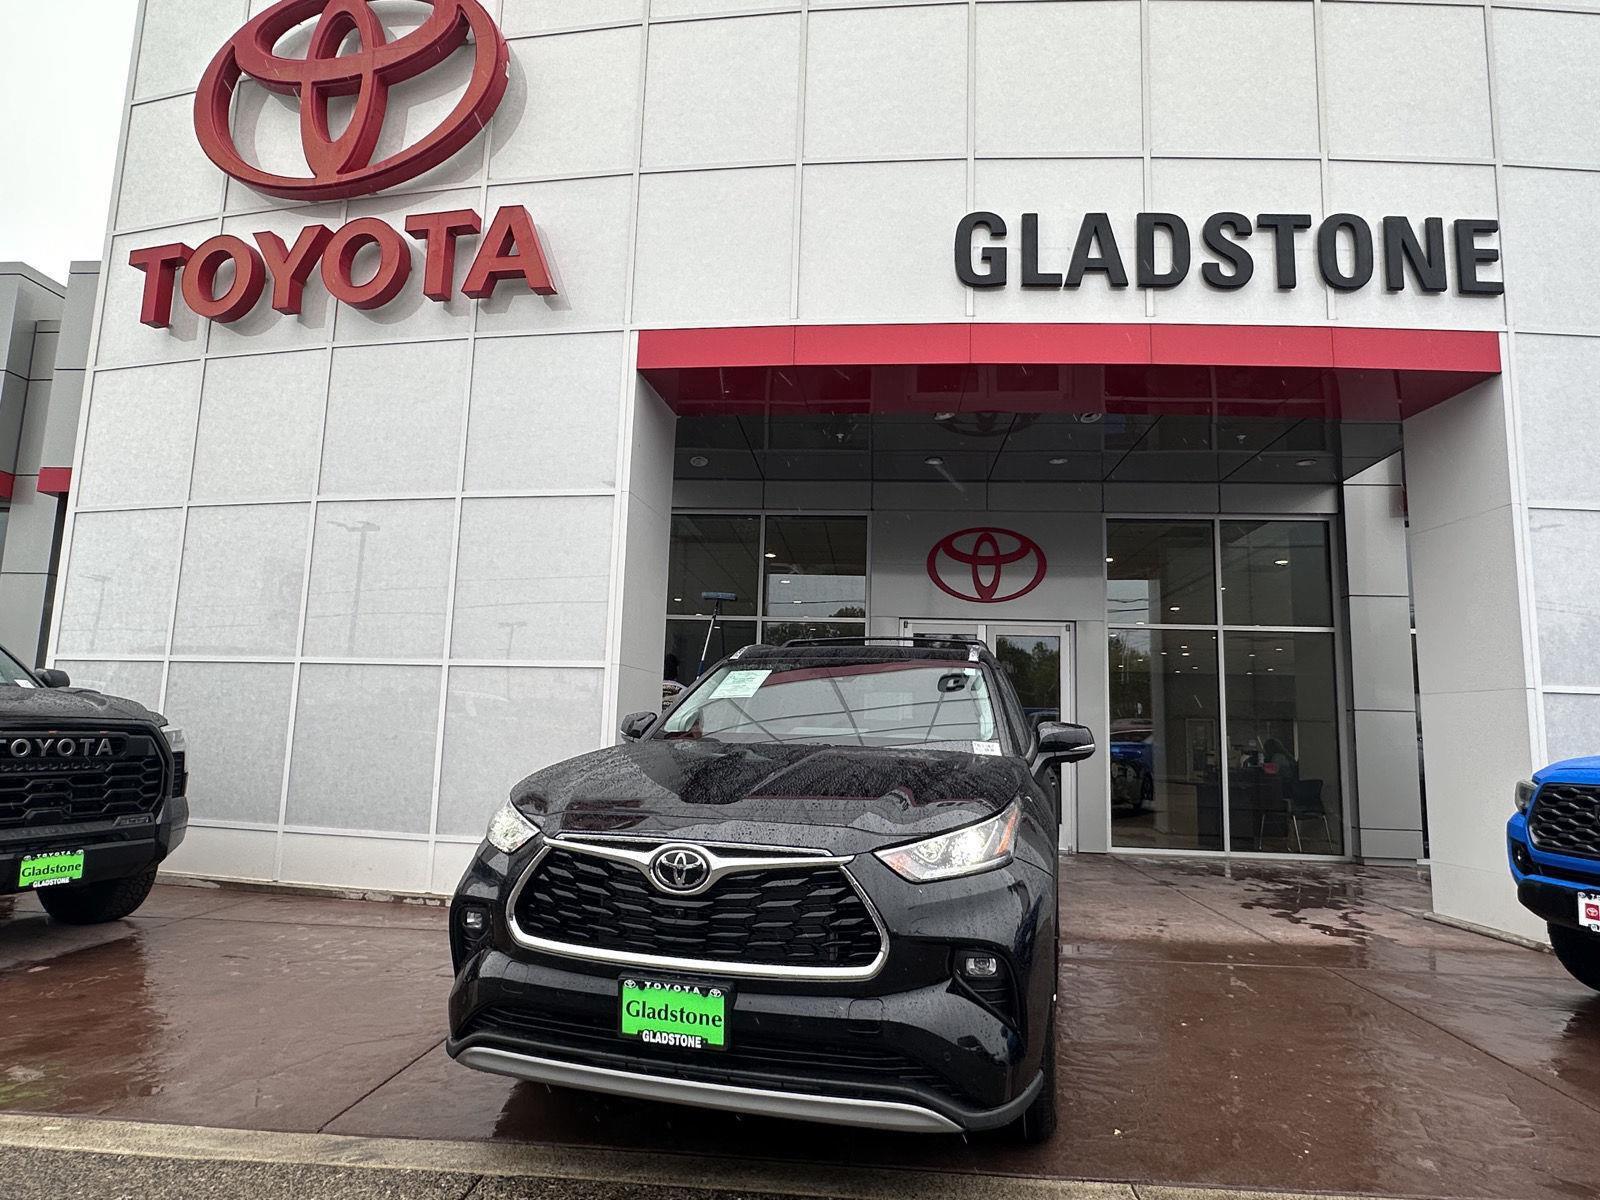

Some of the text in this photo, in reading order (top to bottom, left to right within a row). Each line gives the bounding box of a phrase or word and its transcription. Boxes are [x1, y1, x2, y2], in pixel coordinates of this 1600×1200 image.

[954, 211, 1504, 295] GLADSTONE
[129, 205, 557, 328] TOYOTA
[37, 850, 71, 859] TOYOTA
[22, 863, 81, 878] Gladstone
[32, 877, 70, 888] GLADSTONE
[644, 981, 701, 995] TOYOTA
[626, 1000, 723, 1028] Gladstone
[642, 1029, 702, 1049] GLADSTONE
